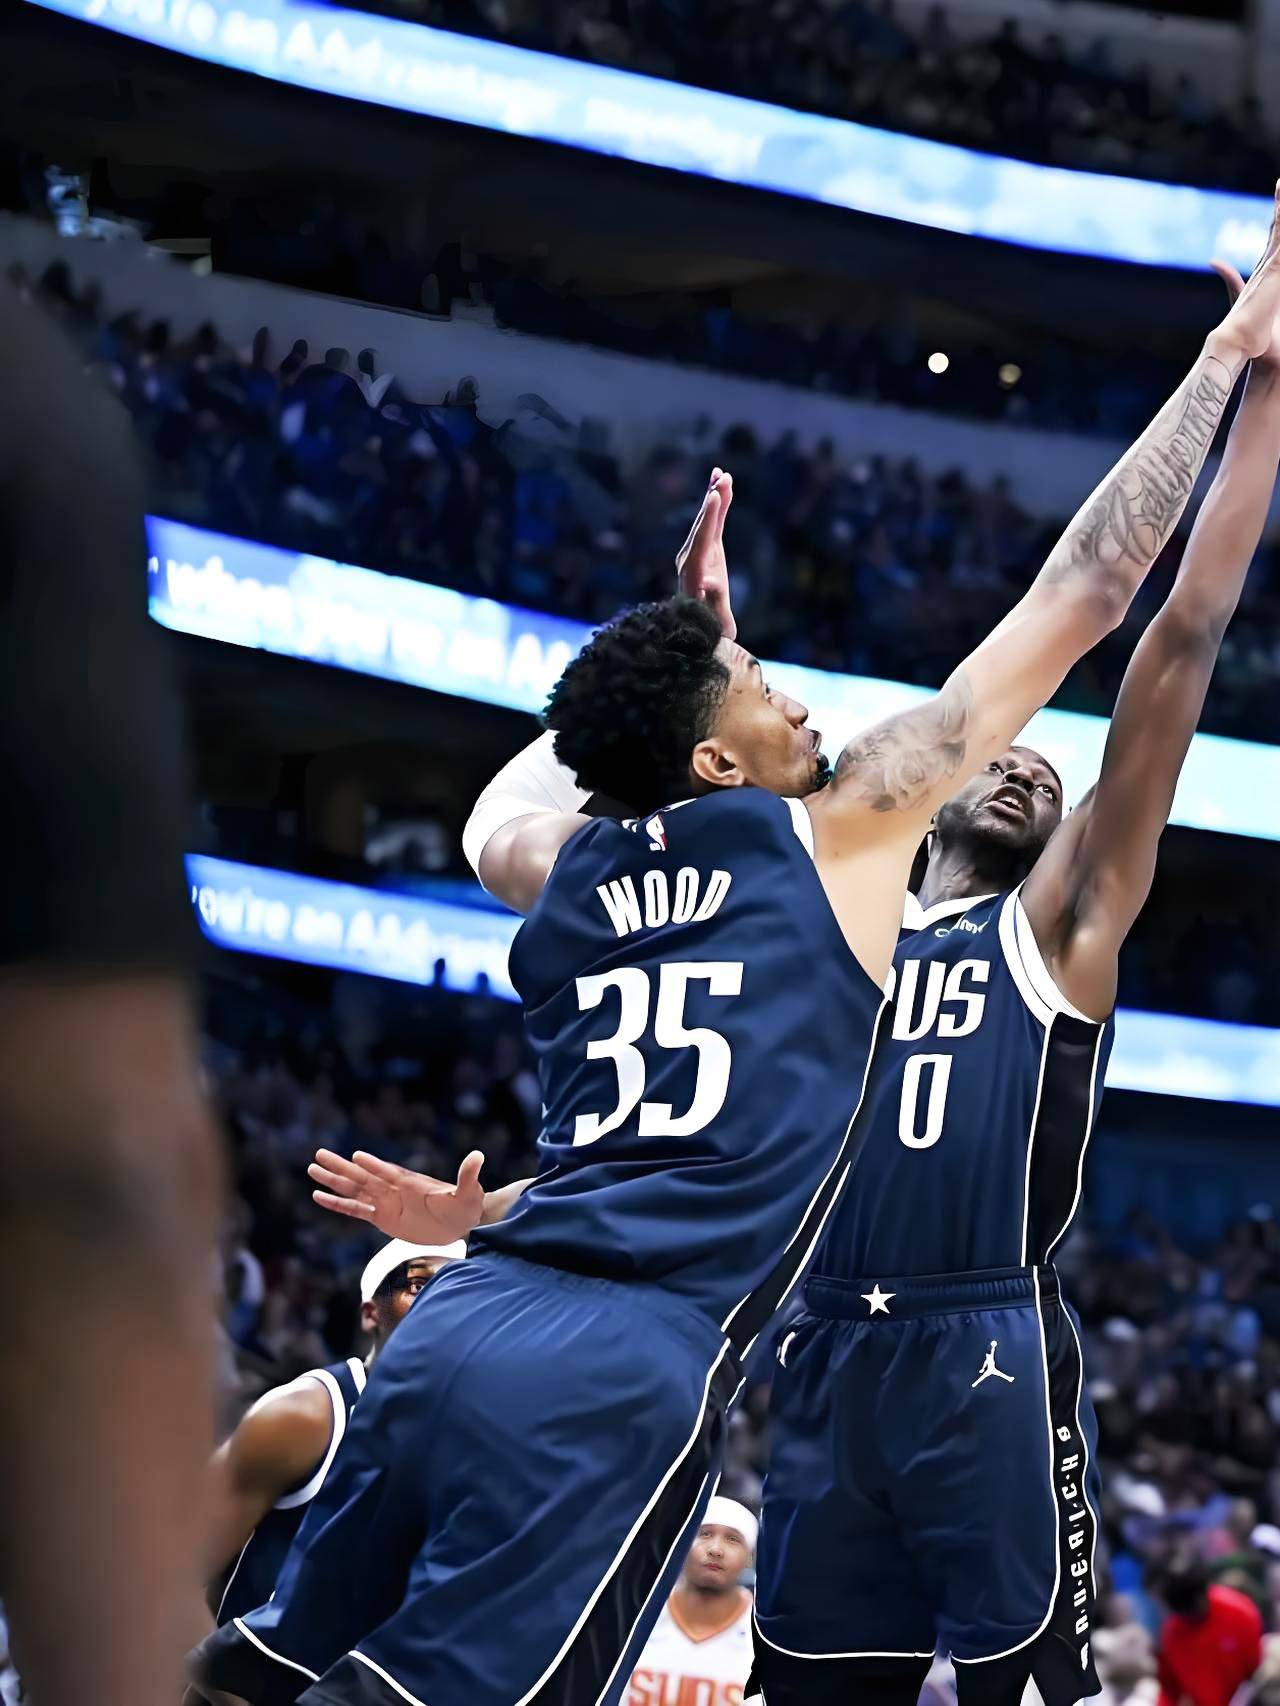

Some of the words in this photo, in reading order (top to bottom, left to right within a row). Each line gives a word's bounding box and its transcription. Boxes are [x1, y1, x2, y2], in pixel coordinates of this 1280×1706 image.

[596, 866, 732, 938] WOOD
[572, 961, 744, 1147] 35
[898, 1053, 953, 1149] 0
